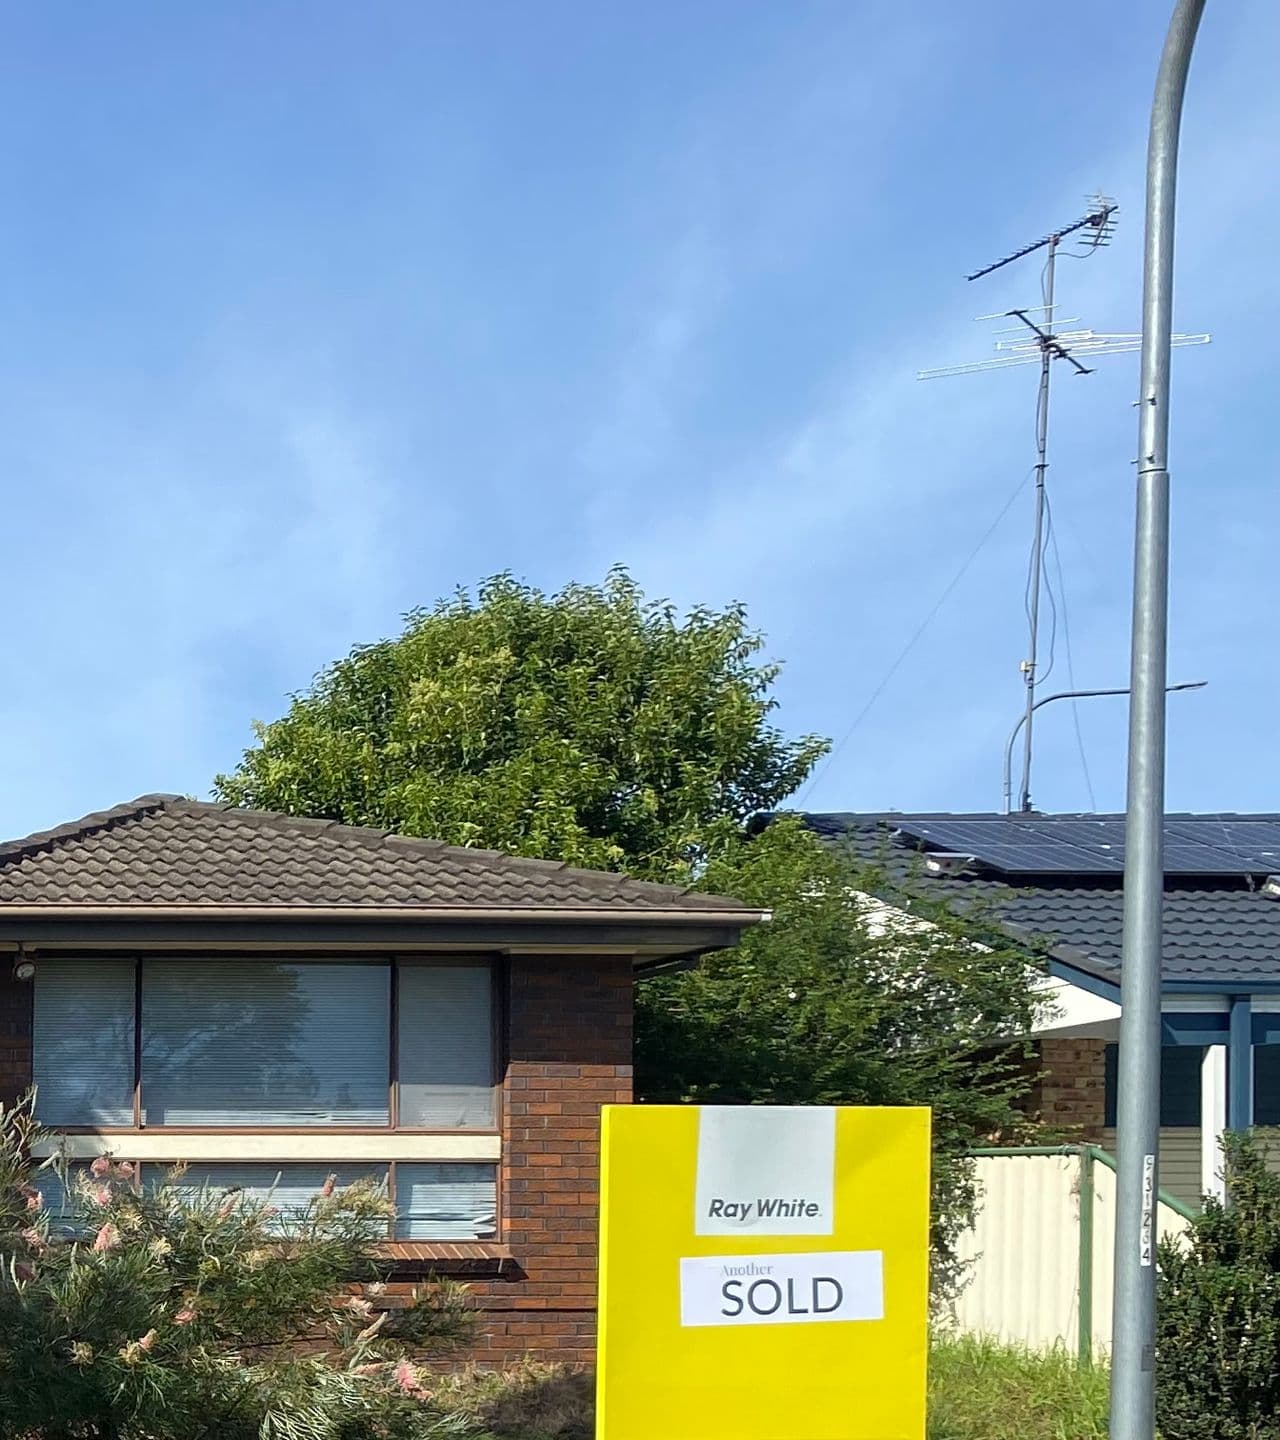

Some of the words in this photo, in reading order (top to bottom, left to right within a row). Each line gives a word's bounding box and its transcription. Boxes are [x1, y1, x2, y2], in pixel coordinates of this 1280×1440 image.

[708, 1198, 752, 1221] Ray
[757, 1198, 819, 1218] White
[720, 1262, 774, 1276] Another
[721, 1277, 843, 1316] SOLD
